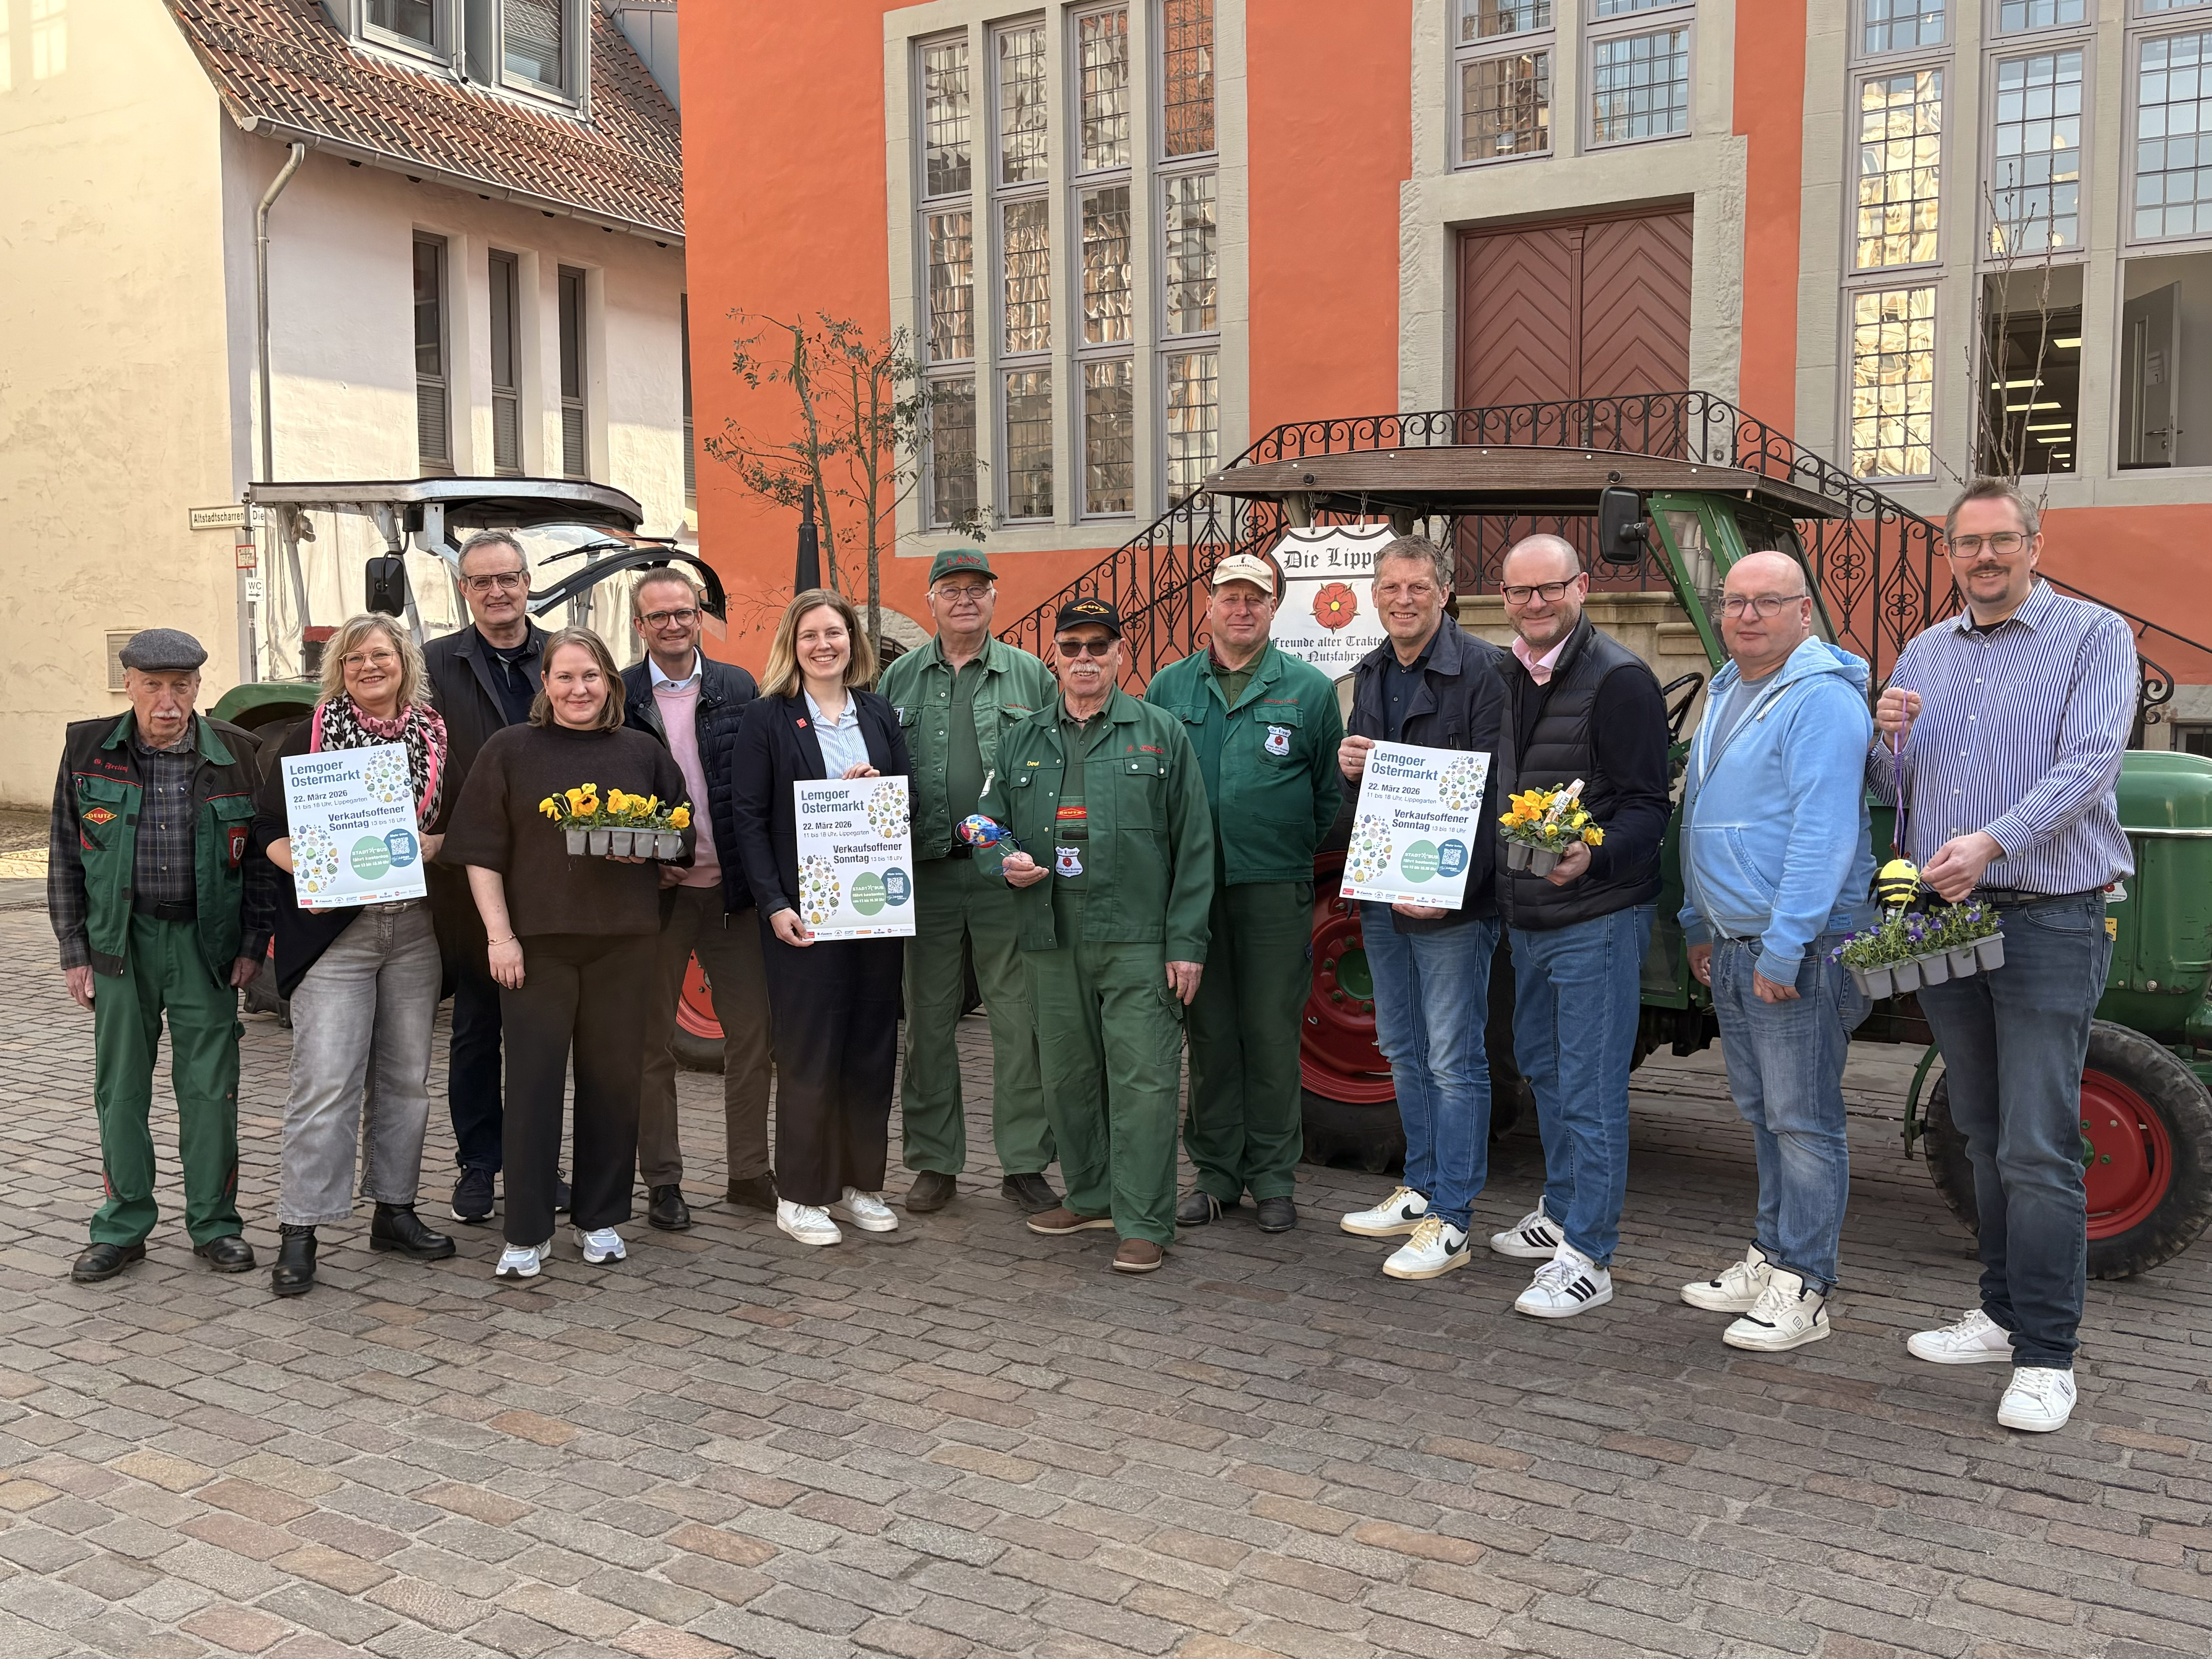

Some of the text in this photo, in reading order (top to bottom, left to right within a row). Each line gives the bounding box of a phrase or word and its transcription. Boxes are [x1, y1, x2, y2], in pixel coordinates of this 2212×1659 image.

[194, 512, 244, 523] Altstadtscharren
[947, 555, 983, 567] LANZ
[1283, 547, 1376, 570] Die Lipp
[248, 582, 262, 590] WC
[1317, 636, 1342, 647] alter
[1306, 651, 1369, 663] Nutzfahrze
[1373, 749, 1426, 766] Lemgoer
[290, 761, 343, 775] Lemgoer
[1372, 762, 1438, 781] Ostermarkt
[291, 769, 361, 787] Ostermarkt
[329, 790, 348, 798] 2026
[1368, 782, 1421, 795] 22. März 2026
[801, 790, 849, 802] Lemgoer
[802, 800, 865, 814] Ostermarkt
[328, 805, 405, 822] Verkaufsoffener
[1395, 809, 1469, 824] Verkaufsoffener
[329, 820, 369, 831] Sonntag
[1392, 819, 1430, 832] Sonntag
[833, 843, 902, 853] Verkaufsoffener
[834, 854, 869, 864] Sonntag
